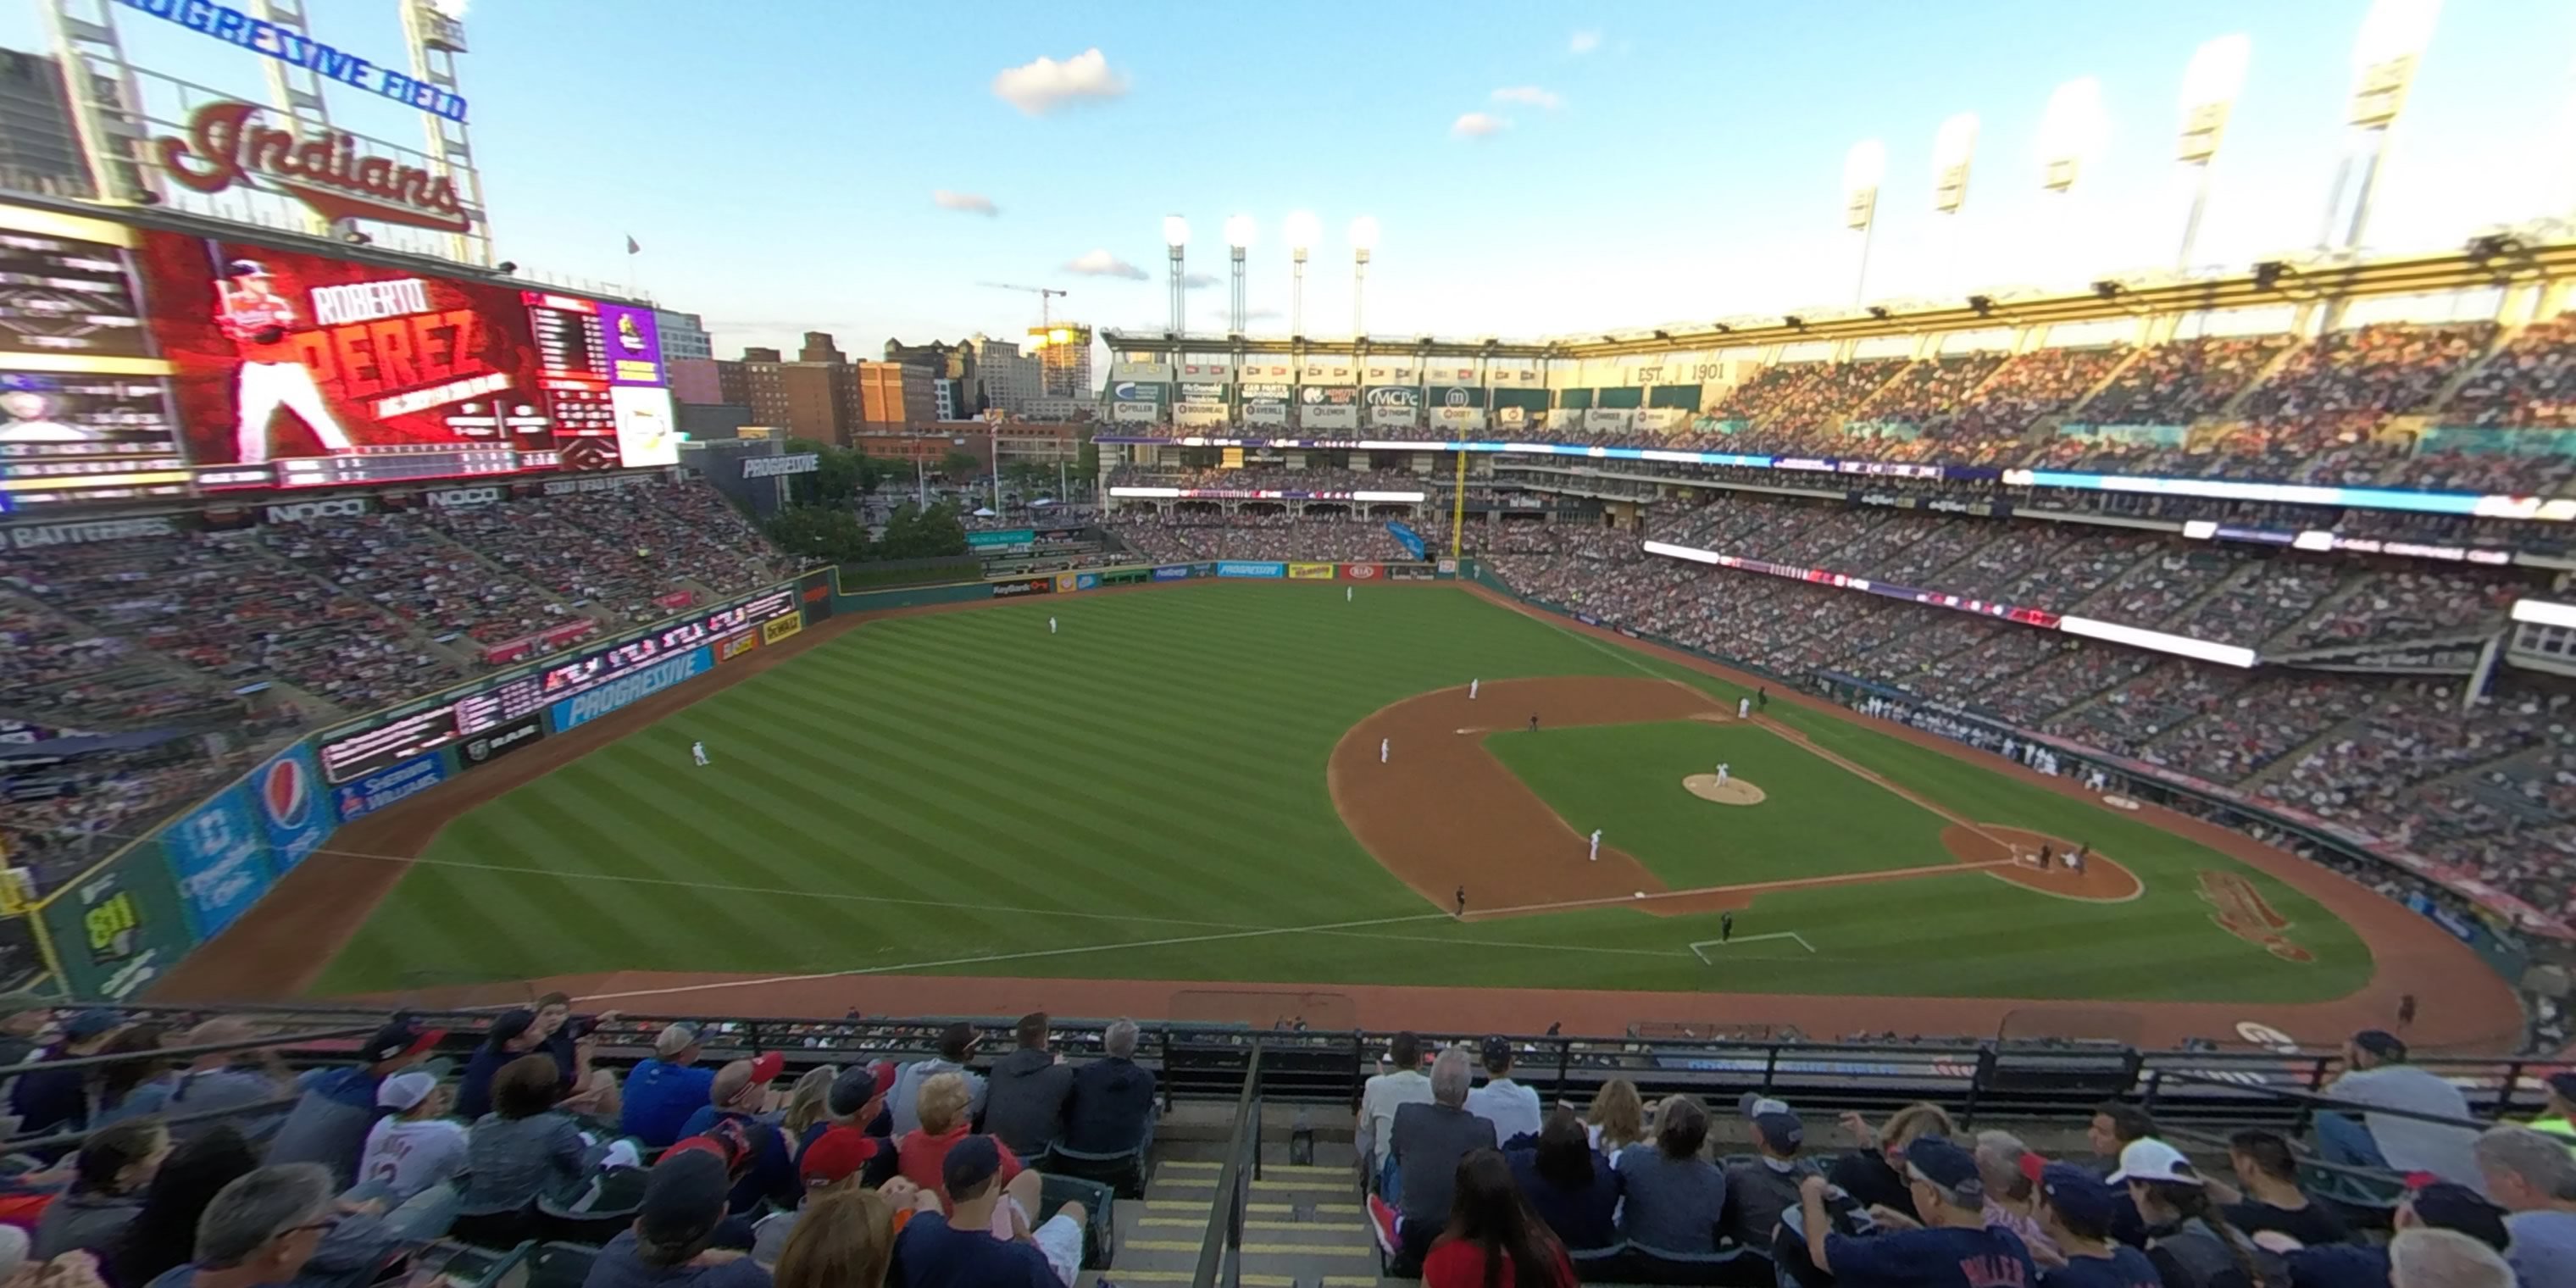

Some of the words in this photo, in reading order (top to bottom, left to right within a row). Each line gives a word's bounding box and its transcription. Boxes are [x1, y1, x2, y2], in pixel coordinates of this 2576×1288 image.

[380, 68, 469, 123] FIELD
[157, 101, 470, 225] Indians
[310, 277, 430, 325] ROBERTO
[290, 308, 483, 400] PEREZ
[1692, 363, 1725, 380] 1901
[742, 453, 820, 480] PROGRESSIVE
[267, 498, 365, 524] NOCO
[425, 486, 499, 506] NOCO
[13, 516, 169, 549] BATTERIES
[993, 582, 1031, 595] KeyBank
[567, 651, 699, 726] PROGRESSIVE
